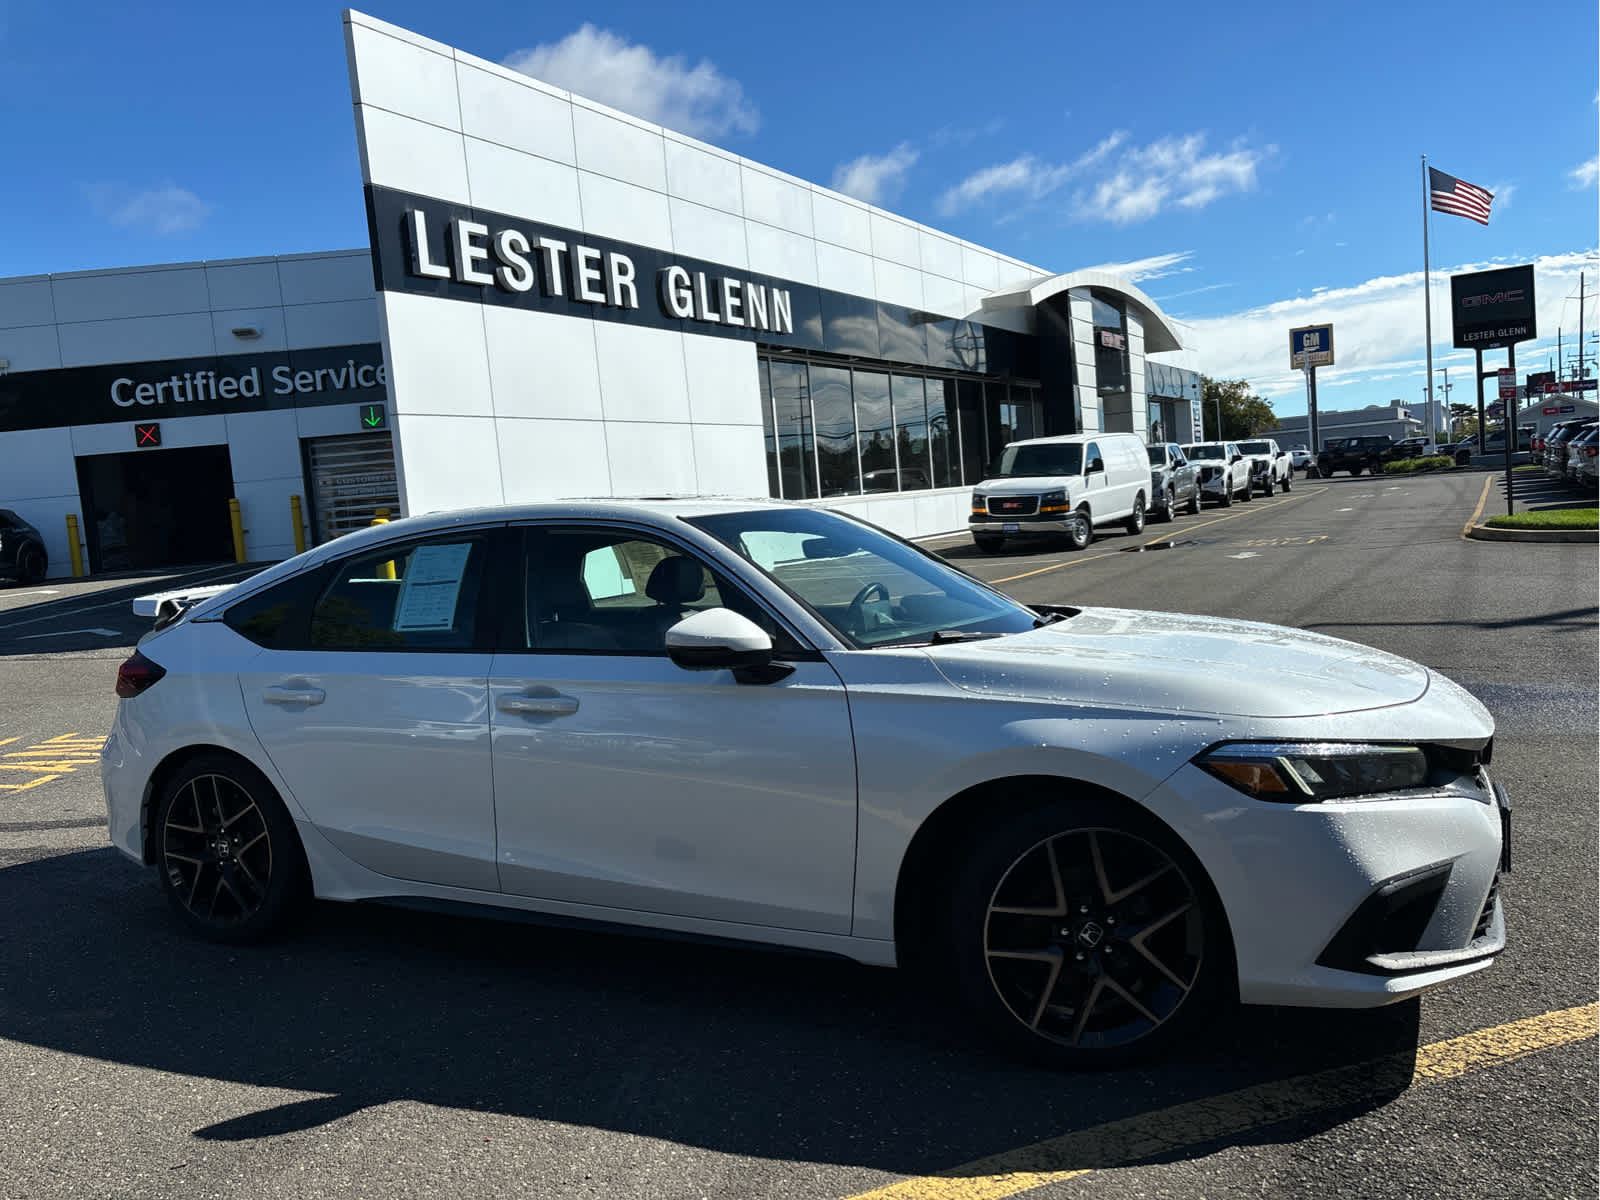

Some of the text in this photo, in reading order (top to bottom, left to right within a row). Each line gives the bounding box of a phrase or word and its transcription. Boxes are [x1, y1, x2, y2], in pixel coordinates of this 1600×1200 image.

[405, 209, 793, 334] LESTER GLENN
[1462, 289, 1524, 307] GMC
[1303, 332, 1320, 347] GM
[1463, 326, 1527, 342] LESTER GLENN
[110, 367, 262, 408] Certified
